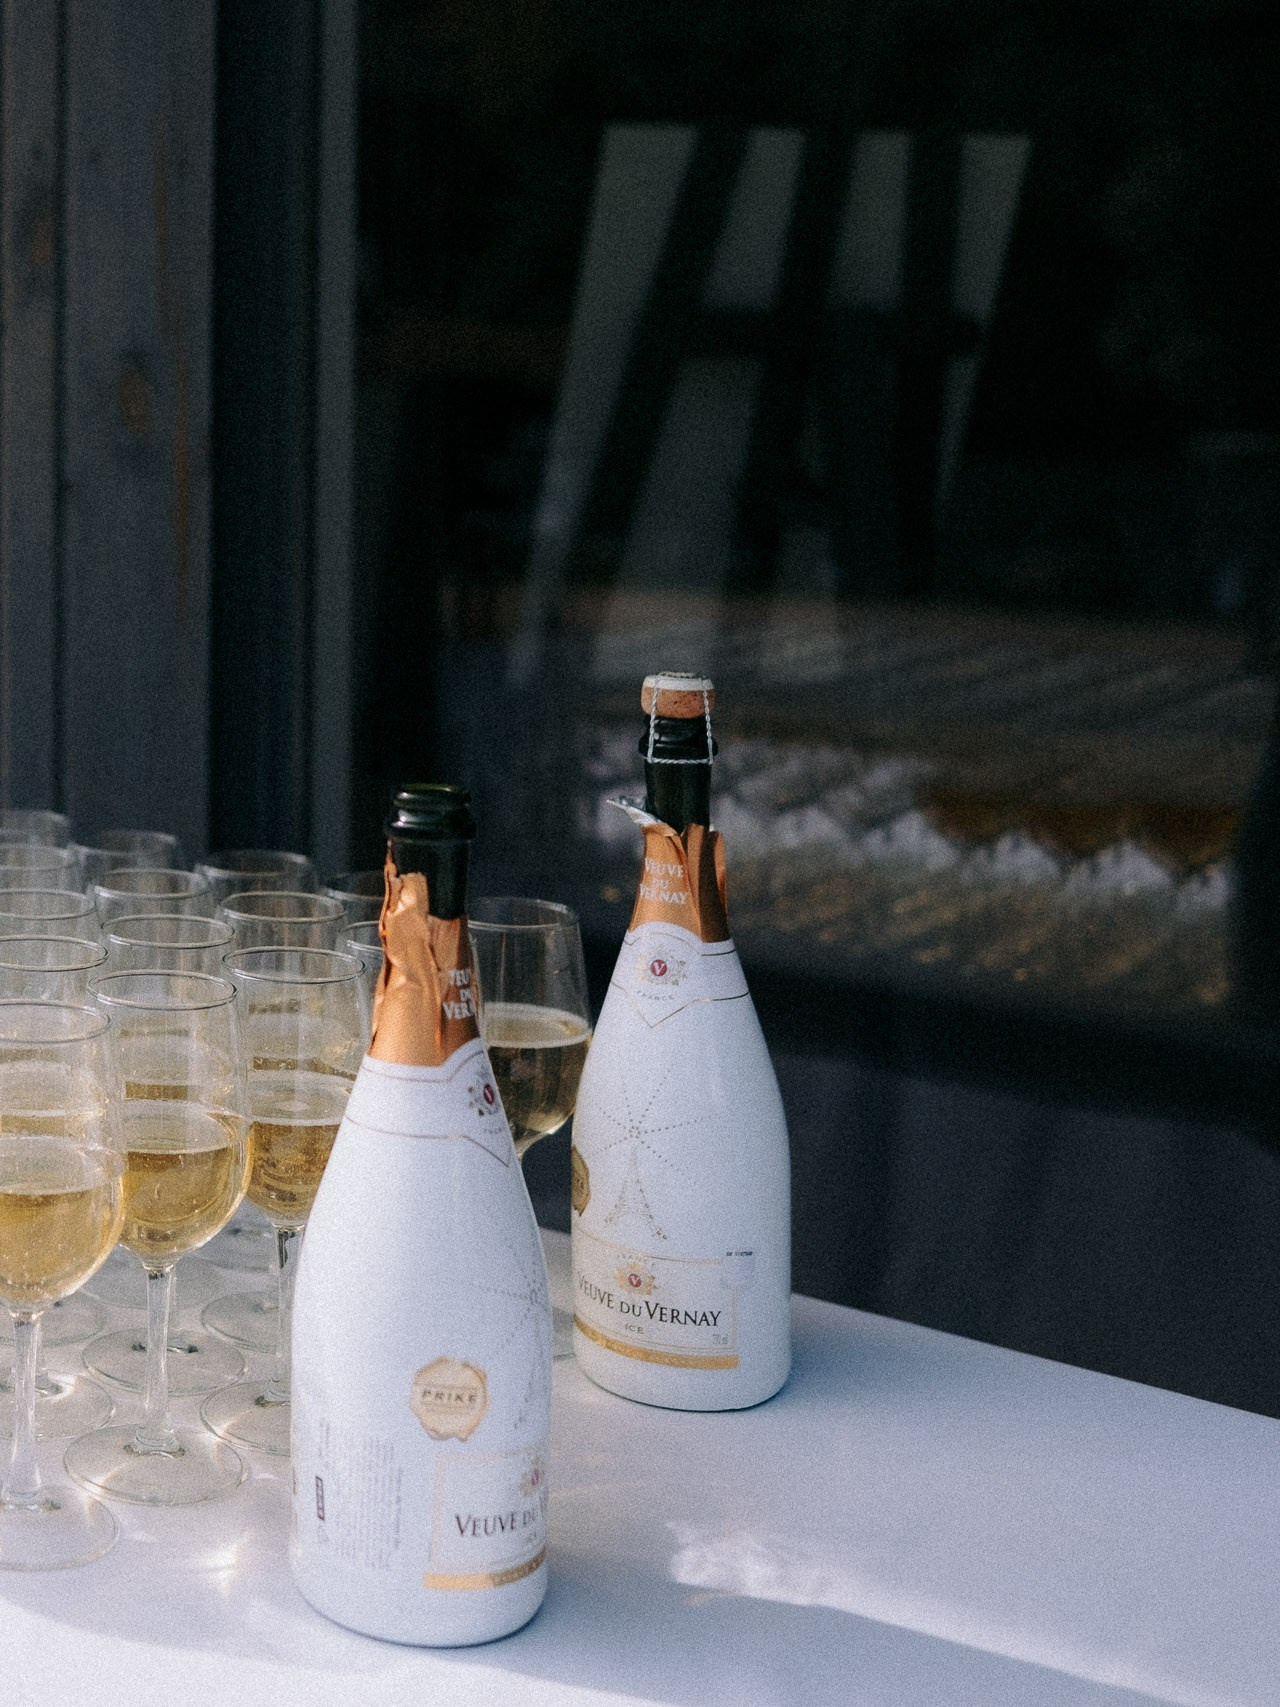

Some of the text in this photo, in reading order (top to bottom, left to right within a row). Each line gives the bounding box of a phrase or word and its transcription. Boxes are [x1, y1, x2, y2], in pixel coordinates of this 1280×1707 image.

[448, 969, 471, 986] VEU
[442, 1001, 477, 1020] VER
[579, 1274, 722, 1327] VEUVE DU VERNAY
[624, 1323, 644, 1335] ICE
[455, 1510, 518, 1537] VEUVE
